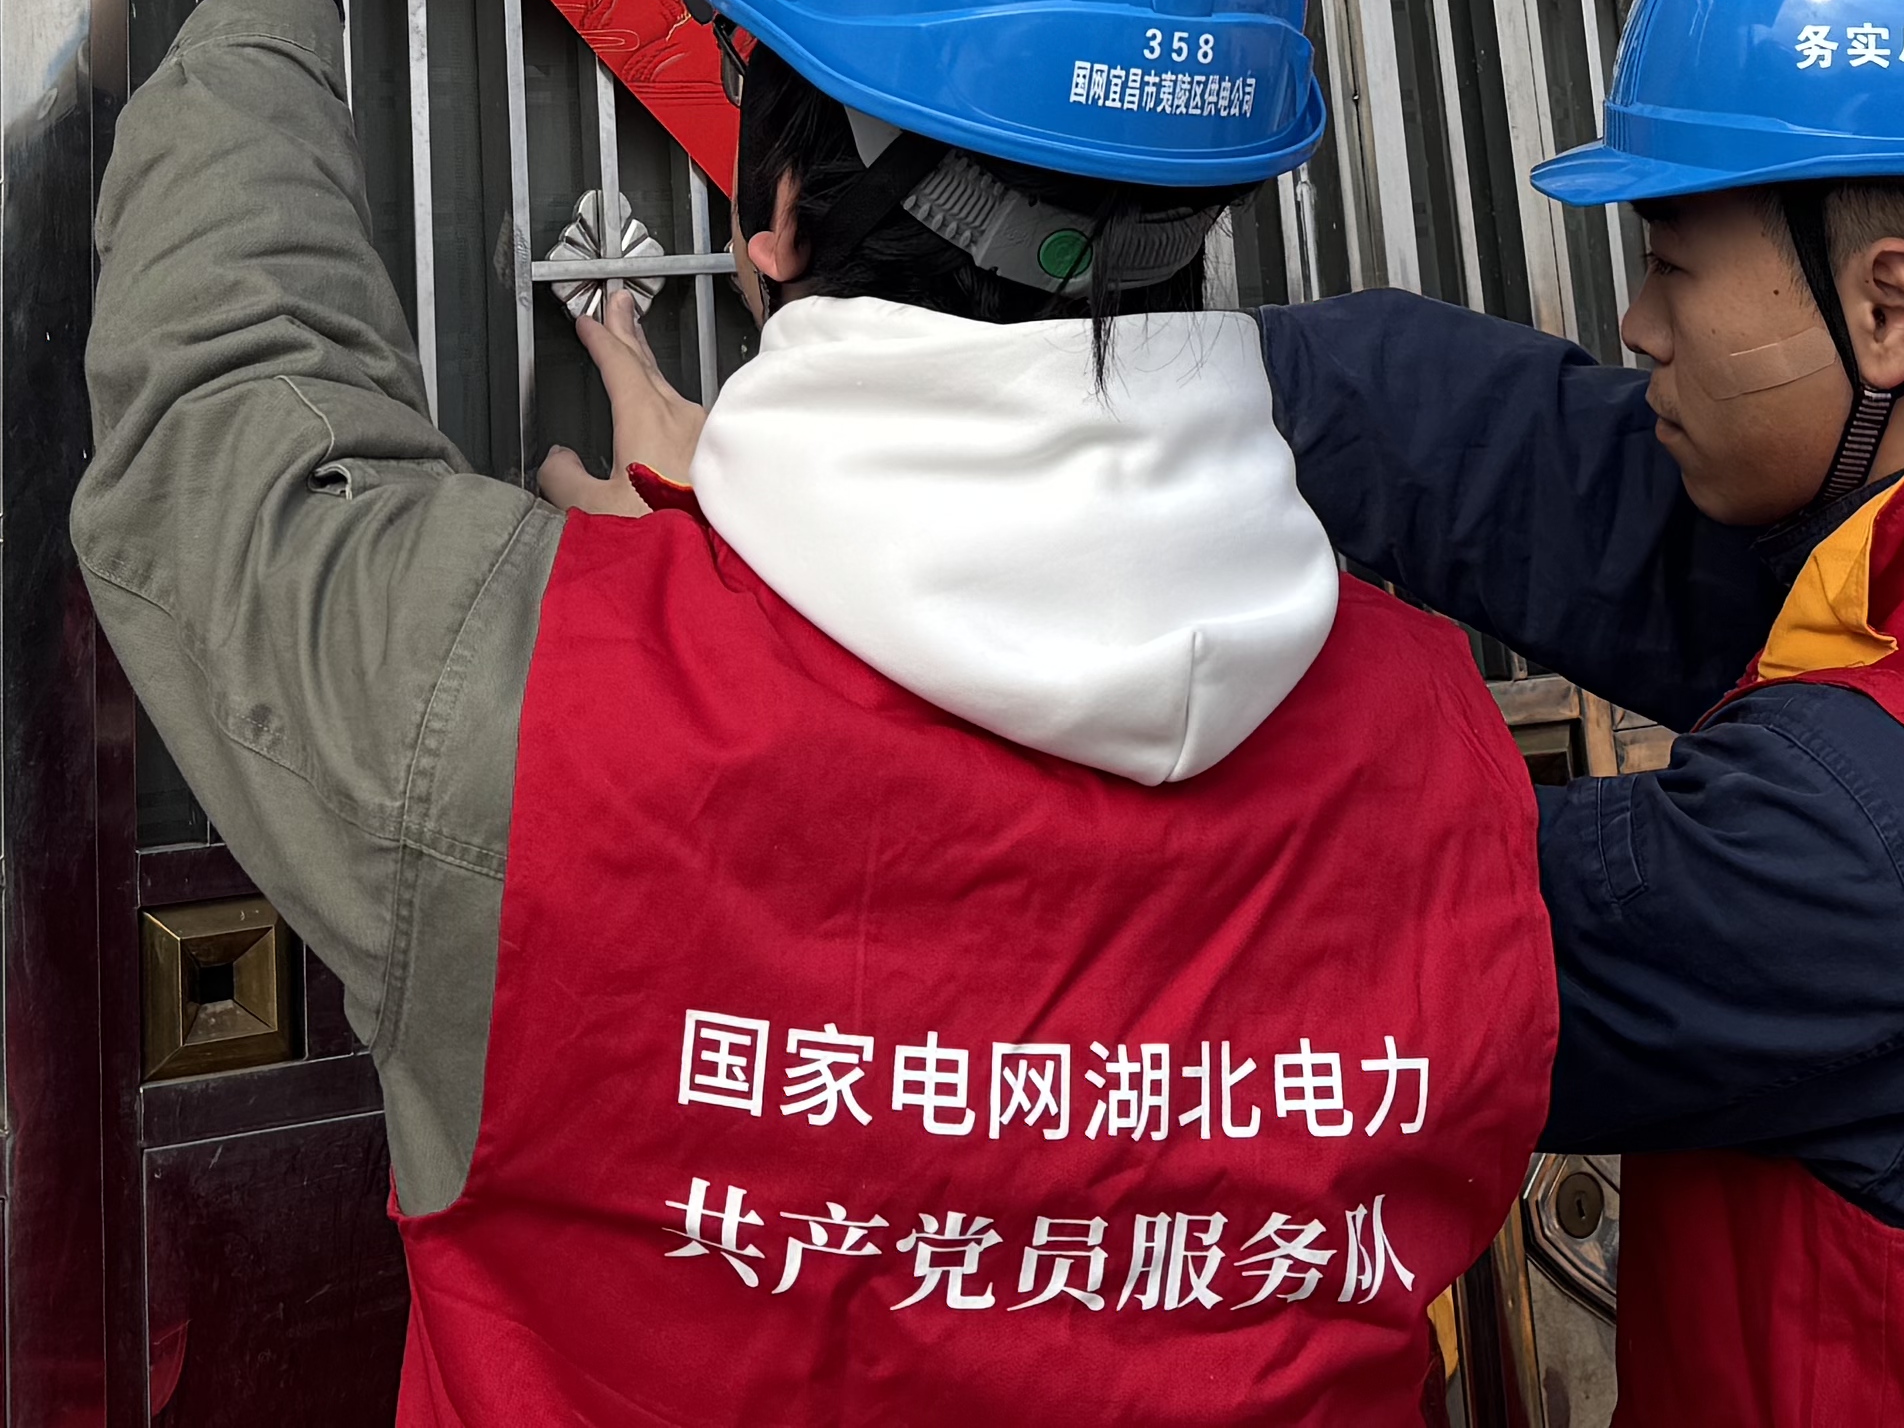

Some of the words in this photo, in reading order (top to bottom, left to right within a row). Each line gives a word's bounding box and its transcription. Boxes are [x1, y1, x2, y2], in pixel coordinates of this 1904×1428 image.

[1069, 59, 1257, 119] 国网宜昌市夷陵区供电公司
[1143, 27, 1215, 65] 358
[676, 1008, 1431, 1143] 国家电网湖北电力
[663, 1175, 1417, 1312] 共产党员服务队
